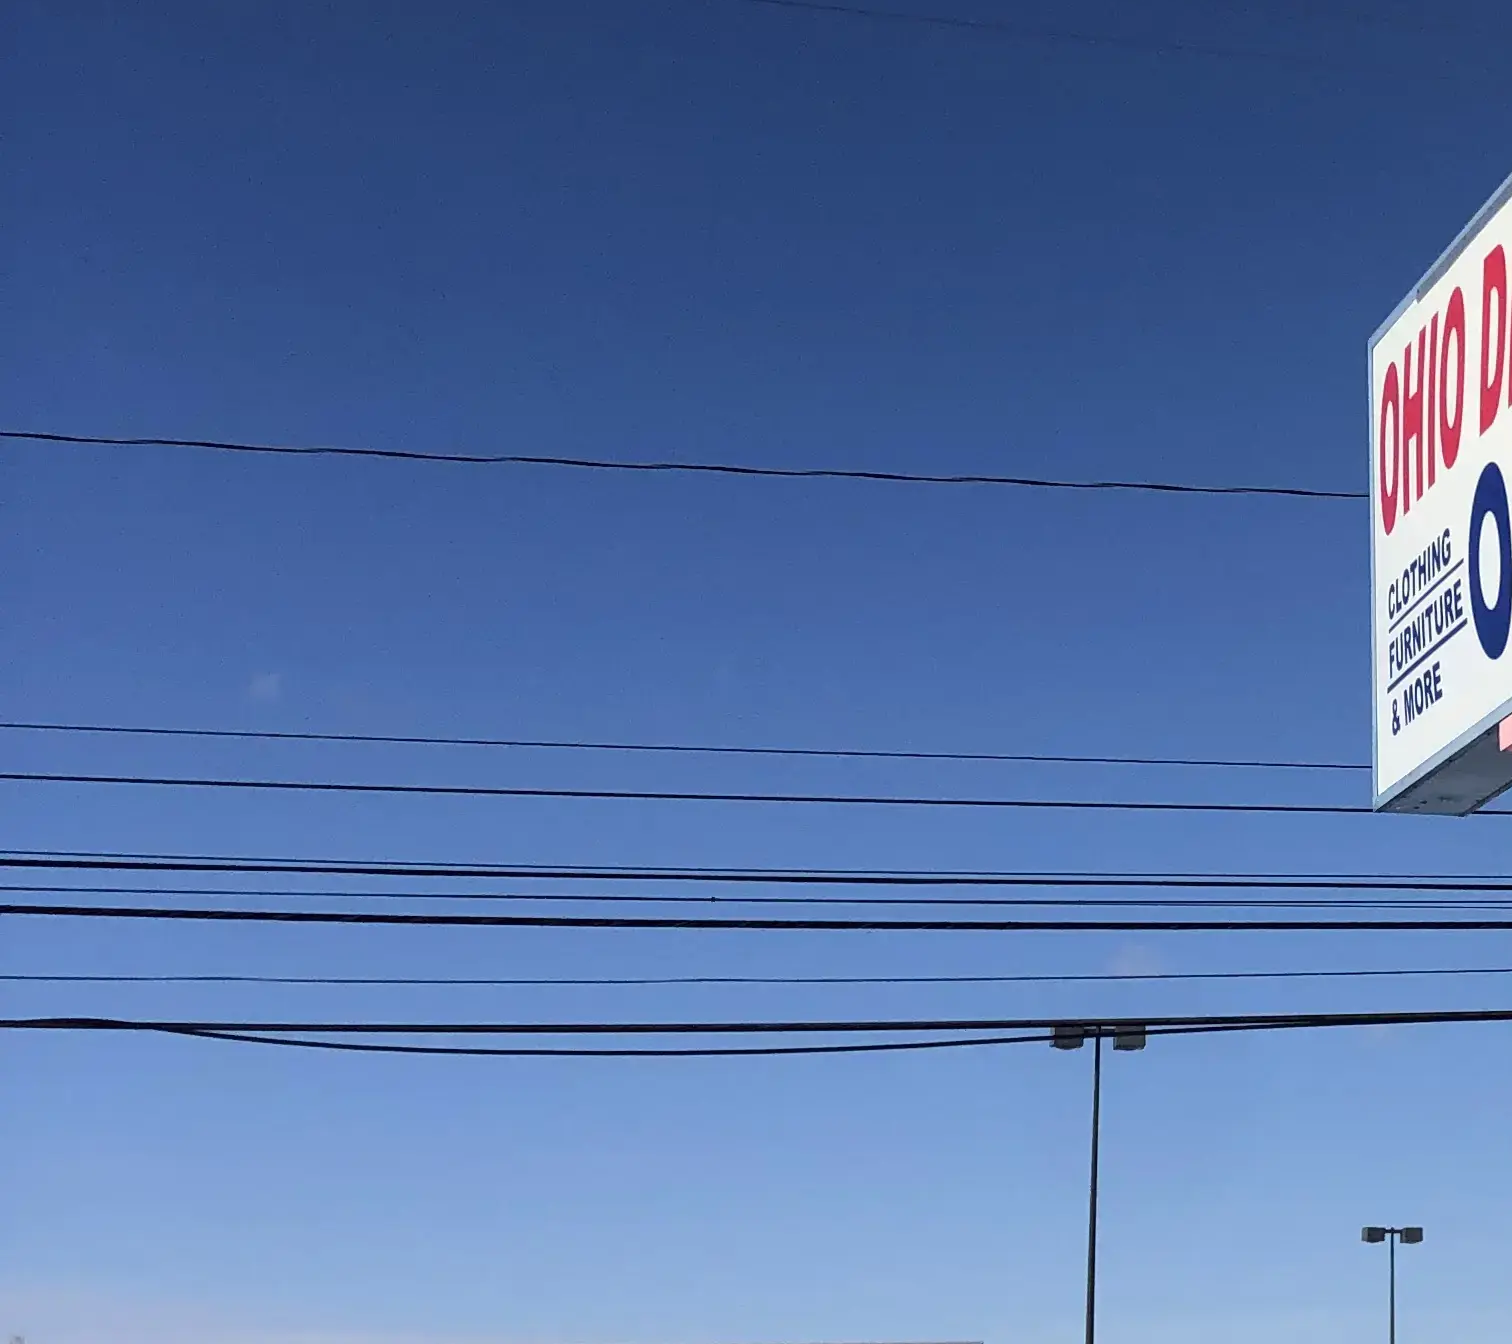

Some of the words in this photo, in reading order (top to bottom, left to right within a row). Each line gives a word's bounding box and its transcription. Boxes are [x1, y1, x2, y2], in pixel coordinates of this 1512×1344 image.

[1380, 287, 1465, 536] OHIO
[1388, 528, 1451, 620] CLOTHING
[1389, 579, 1463, 678] FURNITURE
[1392, 699, 1401, 736] &
[1404, 661, 1443, 726] MORE
